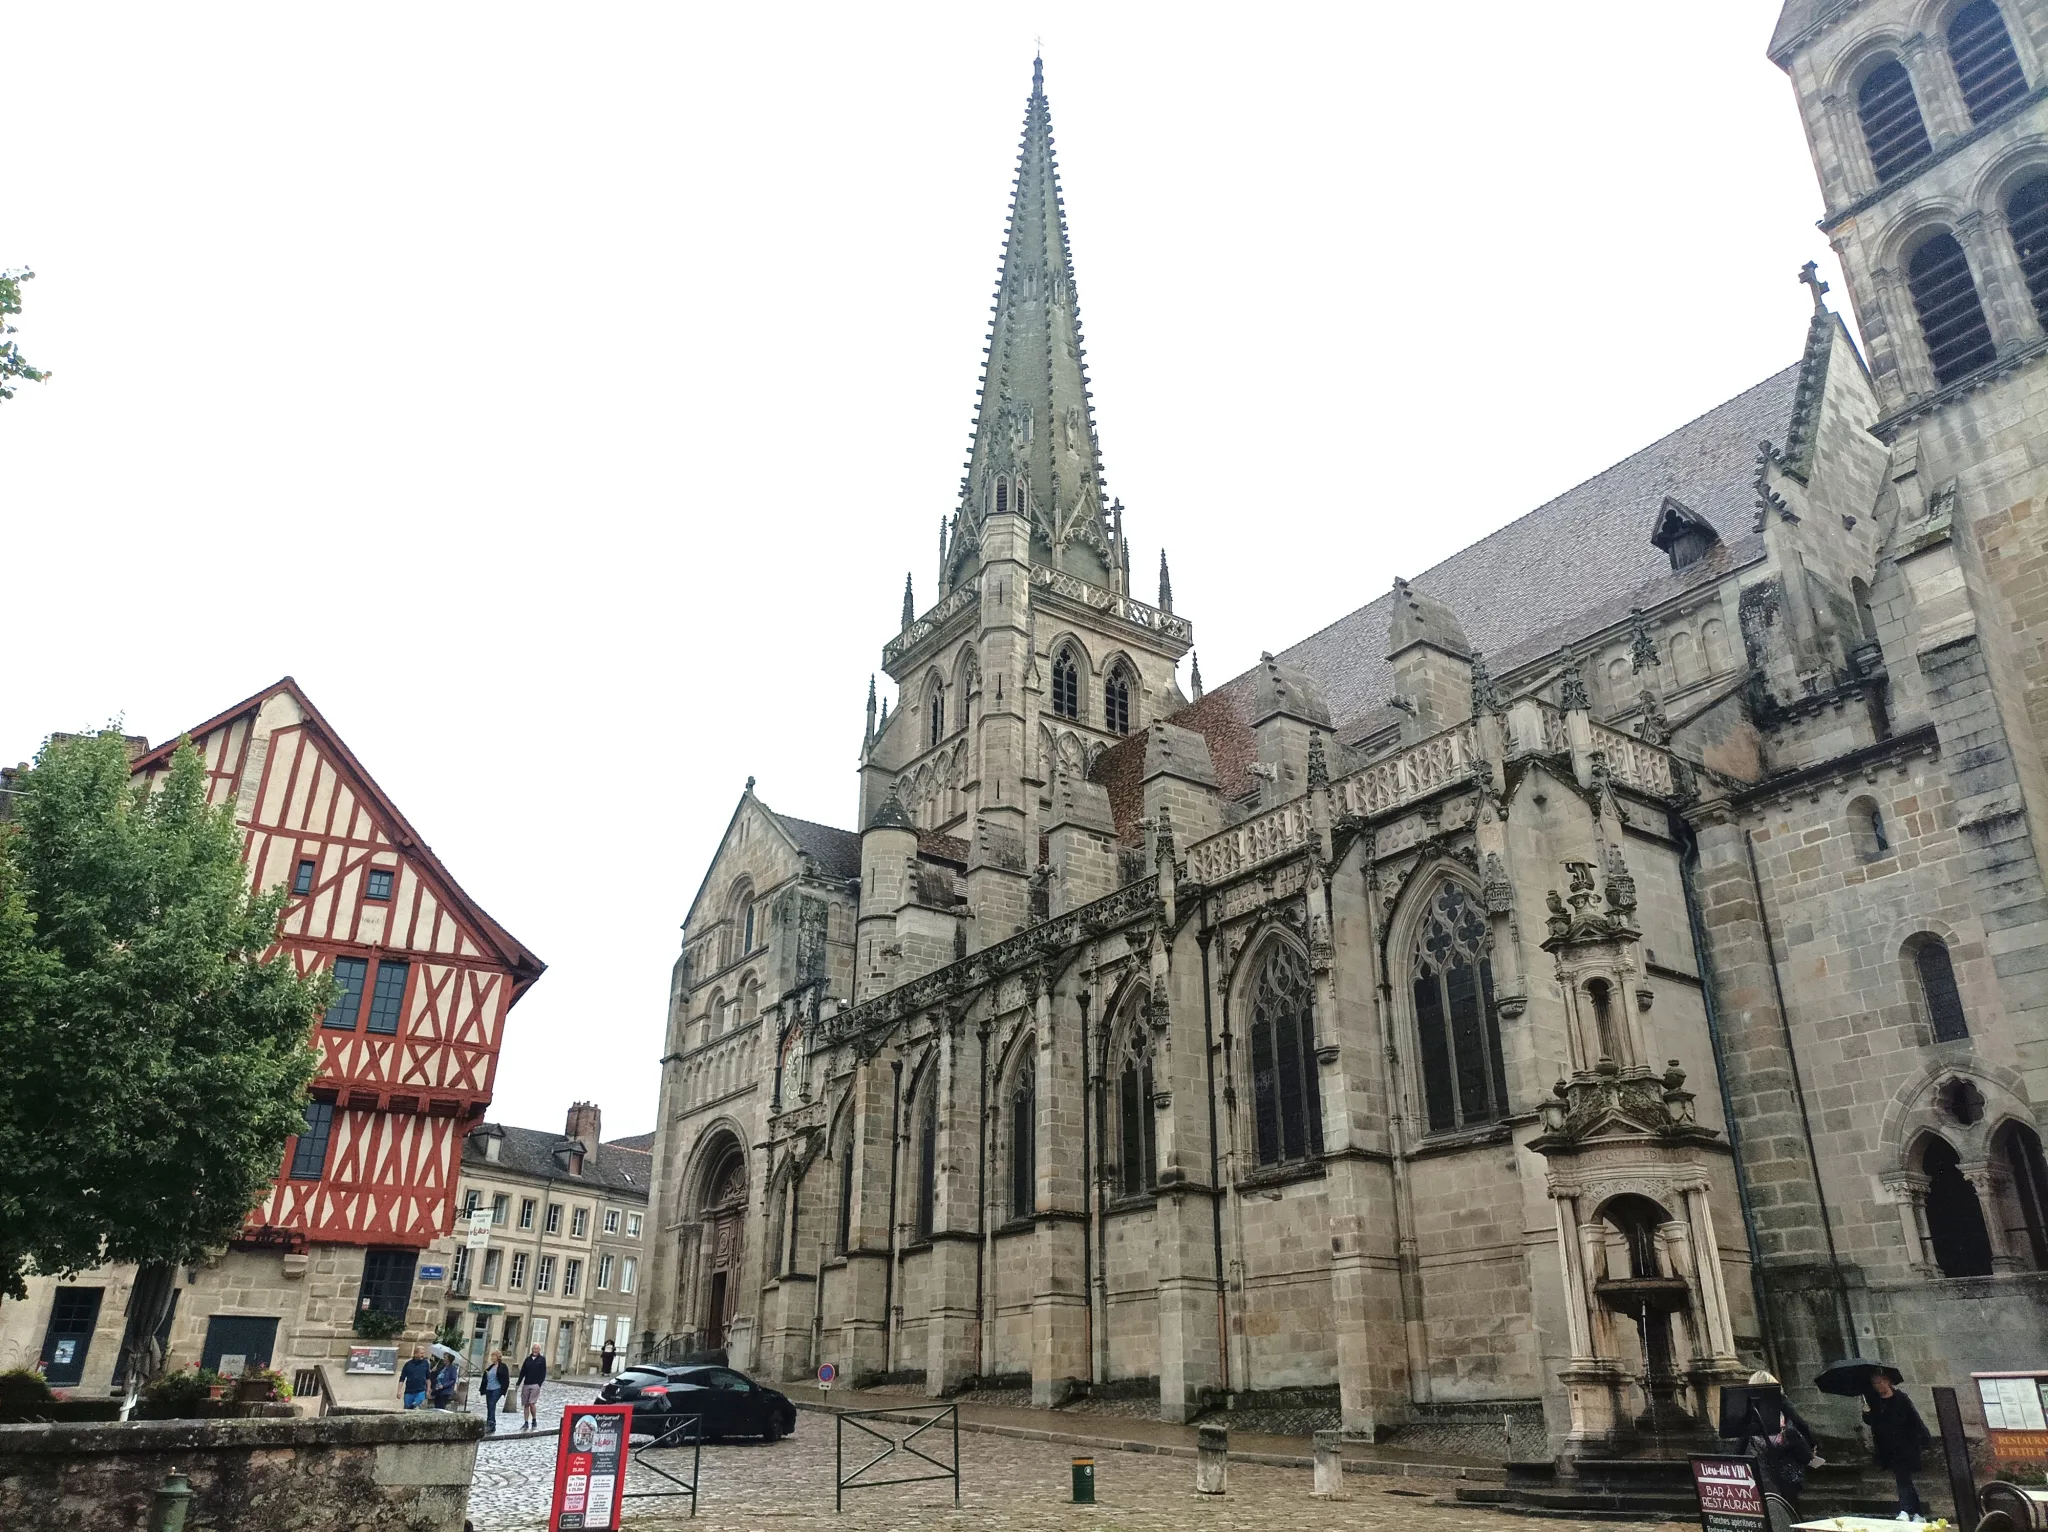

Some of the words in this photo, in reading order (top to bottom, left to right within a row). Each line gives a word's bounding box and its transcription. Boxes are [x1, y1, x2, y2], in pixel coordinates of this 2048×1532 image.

[1994, 1447, 2006, 1456] LE
[2008, 1447, 2034, 1456] PETIT
[1701, 1463, 1730, 1476] Lieu-dit
[1731, 1465, 1746, 1478] VIN
[1706, 1485, 1724, 1497] BAR
[1726, 1485, 1734, 1498] À
[1735, 1487, 1753, 1499] VIN
[1702, 1497, 1760, 1511] RESTAURANT
[1708, 1514, 1731, 1526] Planches
